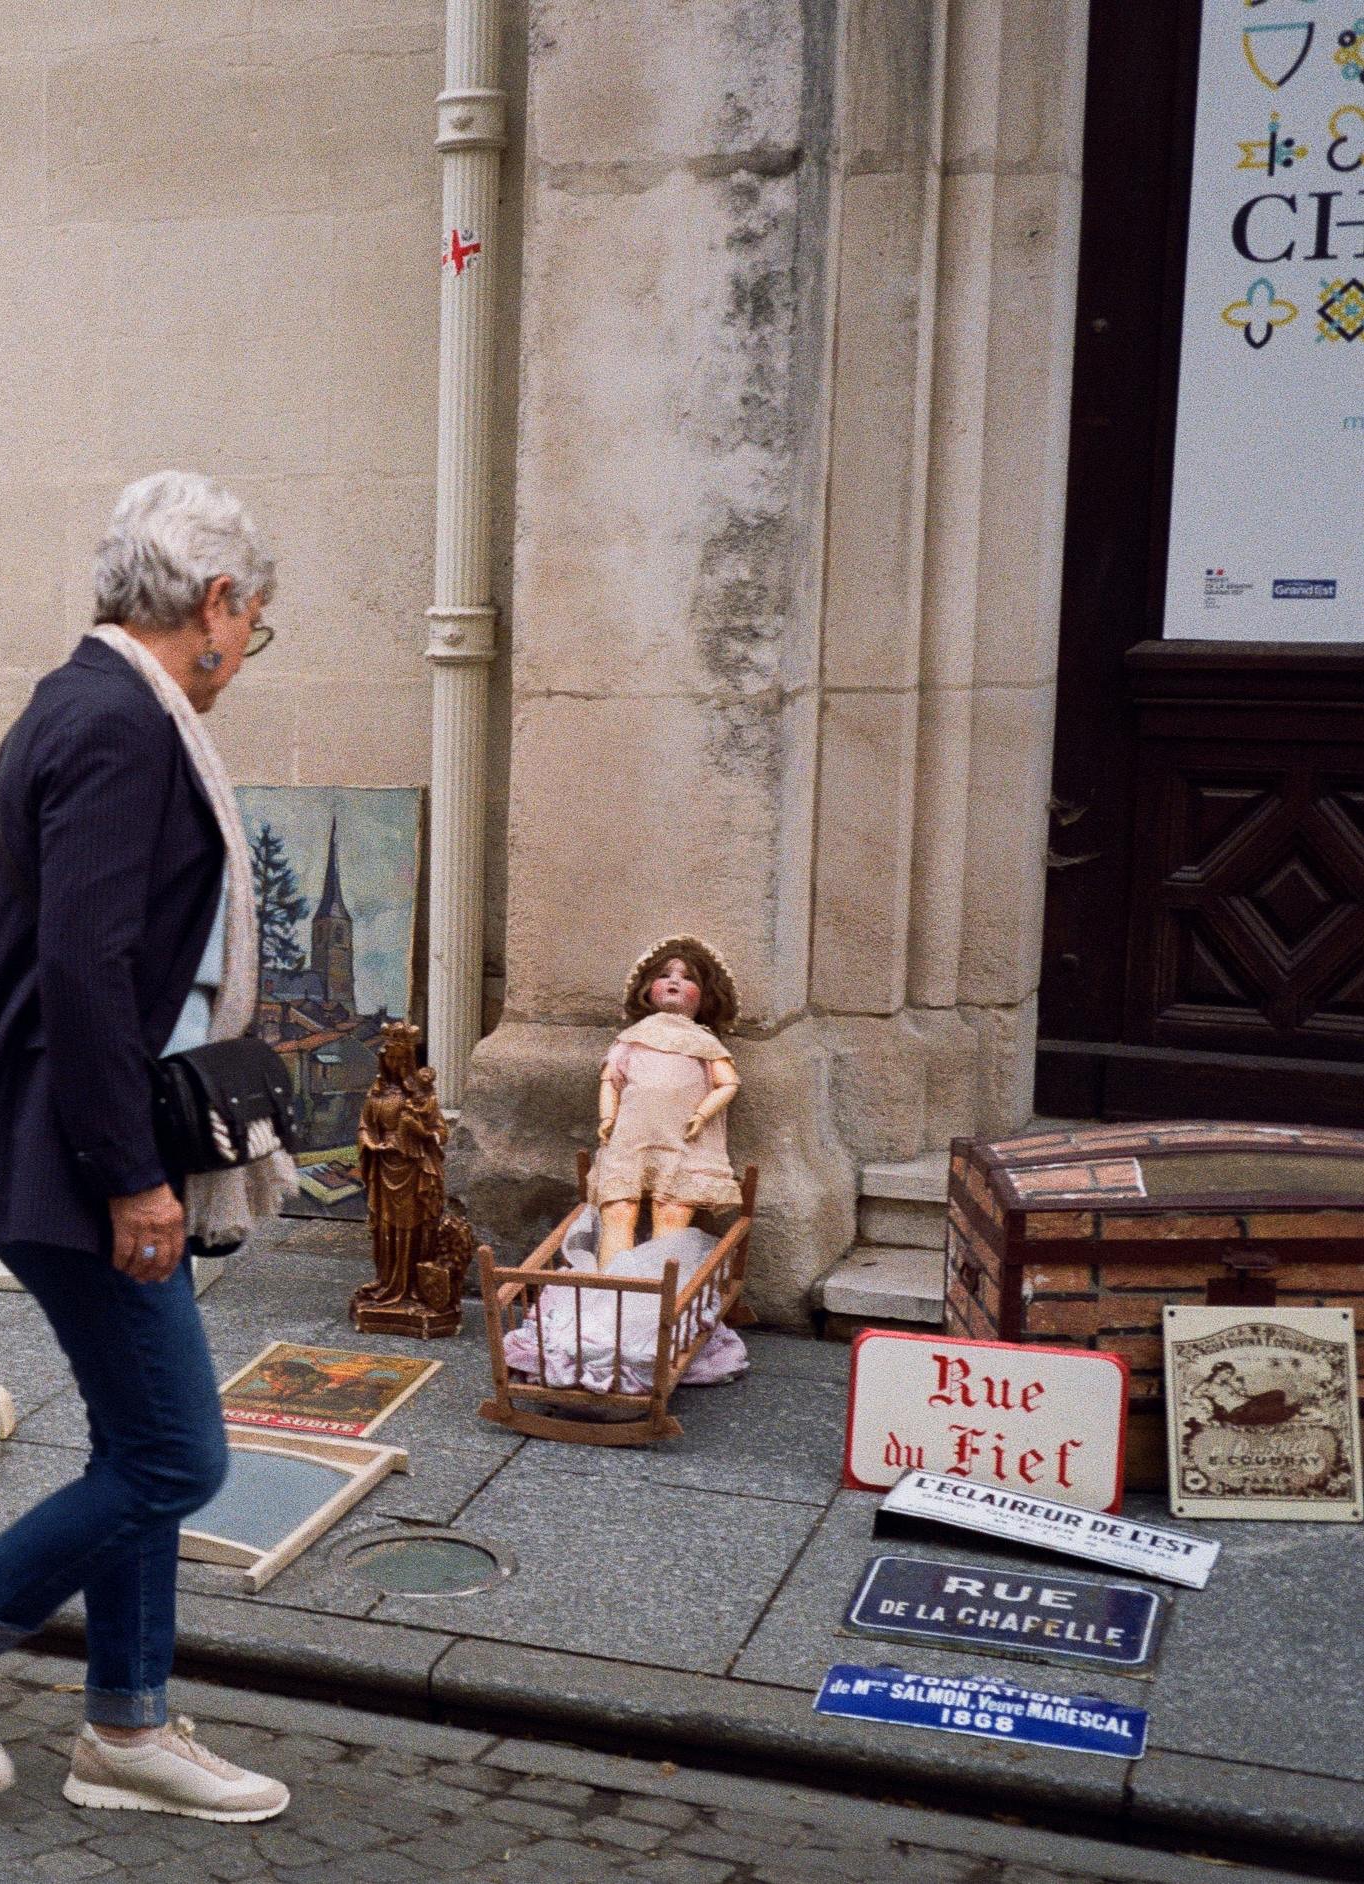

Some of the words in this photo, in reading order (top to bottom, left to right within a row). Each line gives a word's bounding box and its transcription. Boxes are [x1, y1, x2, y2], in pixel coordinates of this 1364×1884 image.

[928, 1353, 1046, 1413] Rue
[223, 1409, 275, 1422] ORT
[277, 1415, 356, 1432] SUBITE
[884, 1431, 925, 1469] du
[945, 1424, 1084, 1488] Fief
[916, 1477, 1084, 1528] L'ECLAIREUR
[1090, 1513, 1122, 1537] DE
[1130, 1530, 1196, 1556] L'EST
[944, 1576, 1078, 1610] RUE
[878, 1599, 909, 1616] DE
[916, 1604, 945, 1622] LA
[956, 1606, 1126, 1648] CHAPELLE
[830, 1679, 850, 1695] de
[978, 1696, 1025, 1716] Veuve
[1026, 1701, 1133, 1738] MARESCAL
[902, 1673, 1072, 1706] FONDATION
[941, 1708, 1015, 1733] 1868
